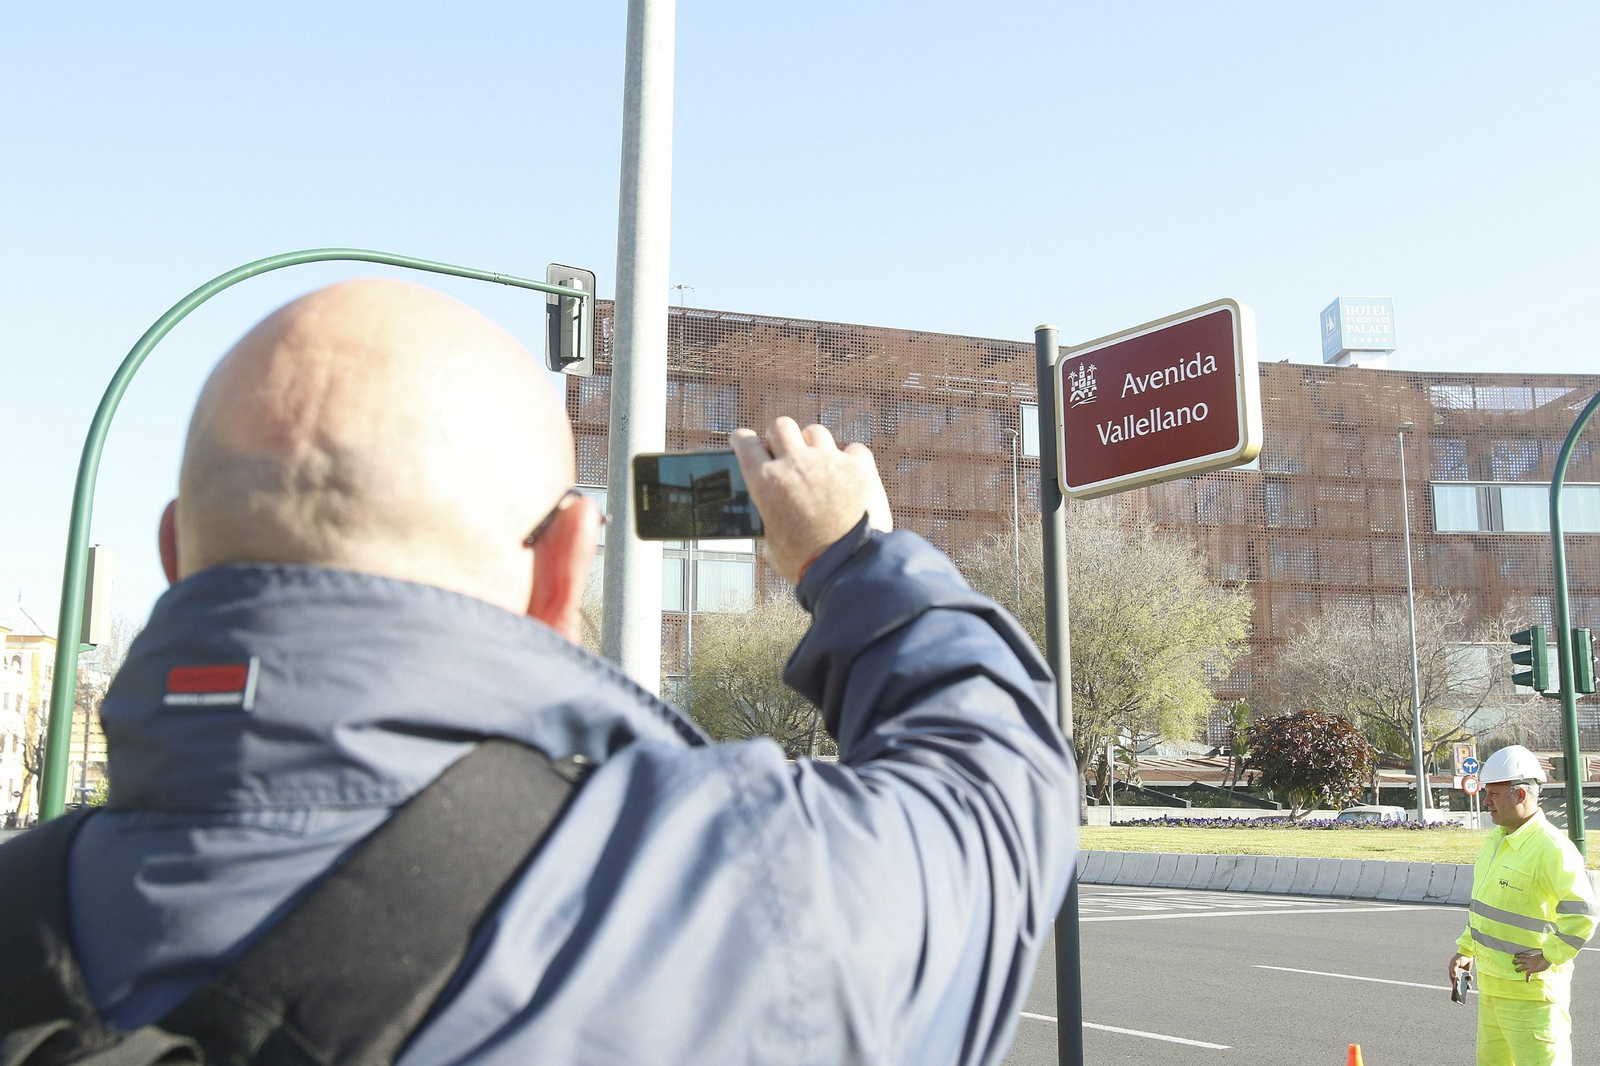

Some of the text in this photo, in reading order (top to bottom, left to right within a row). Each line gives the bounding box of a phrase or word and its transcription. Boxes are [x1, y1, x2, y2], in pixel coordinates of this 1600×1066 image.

[1345, 305, 1390, 316] HOTEL
[1346, 316, 1390, 324] EUROSTARS
[1346, 324, 1391, 334] PALACE
[1120, 351, 1218, 399] Avenida
[1096, 402, 1209, 446] Vallellano
